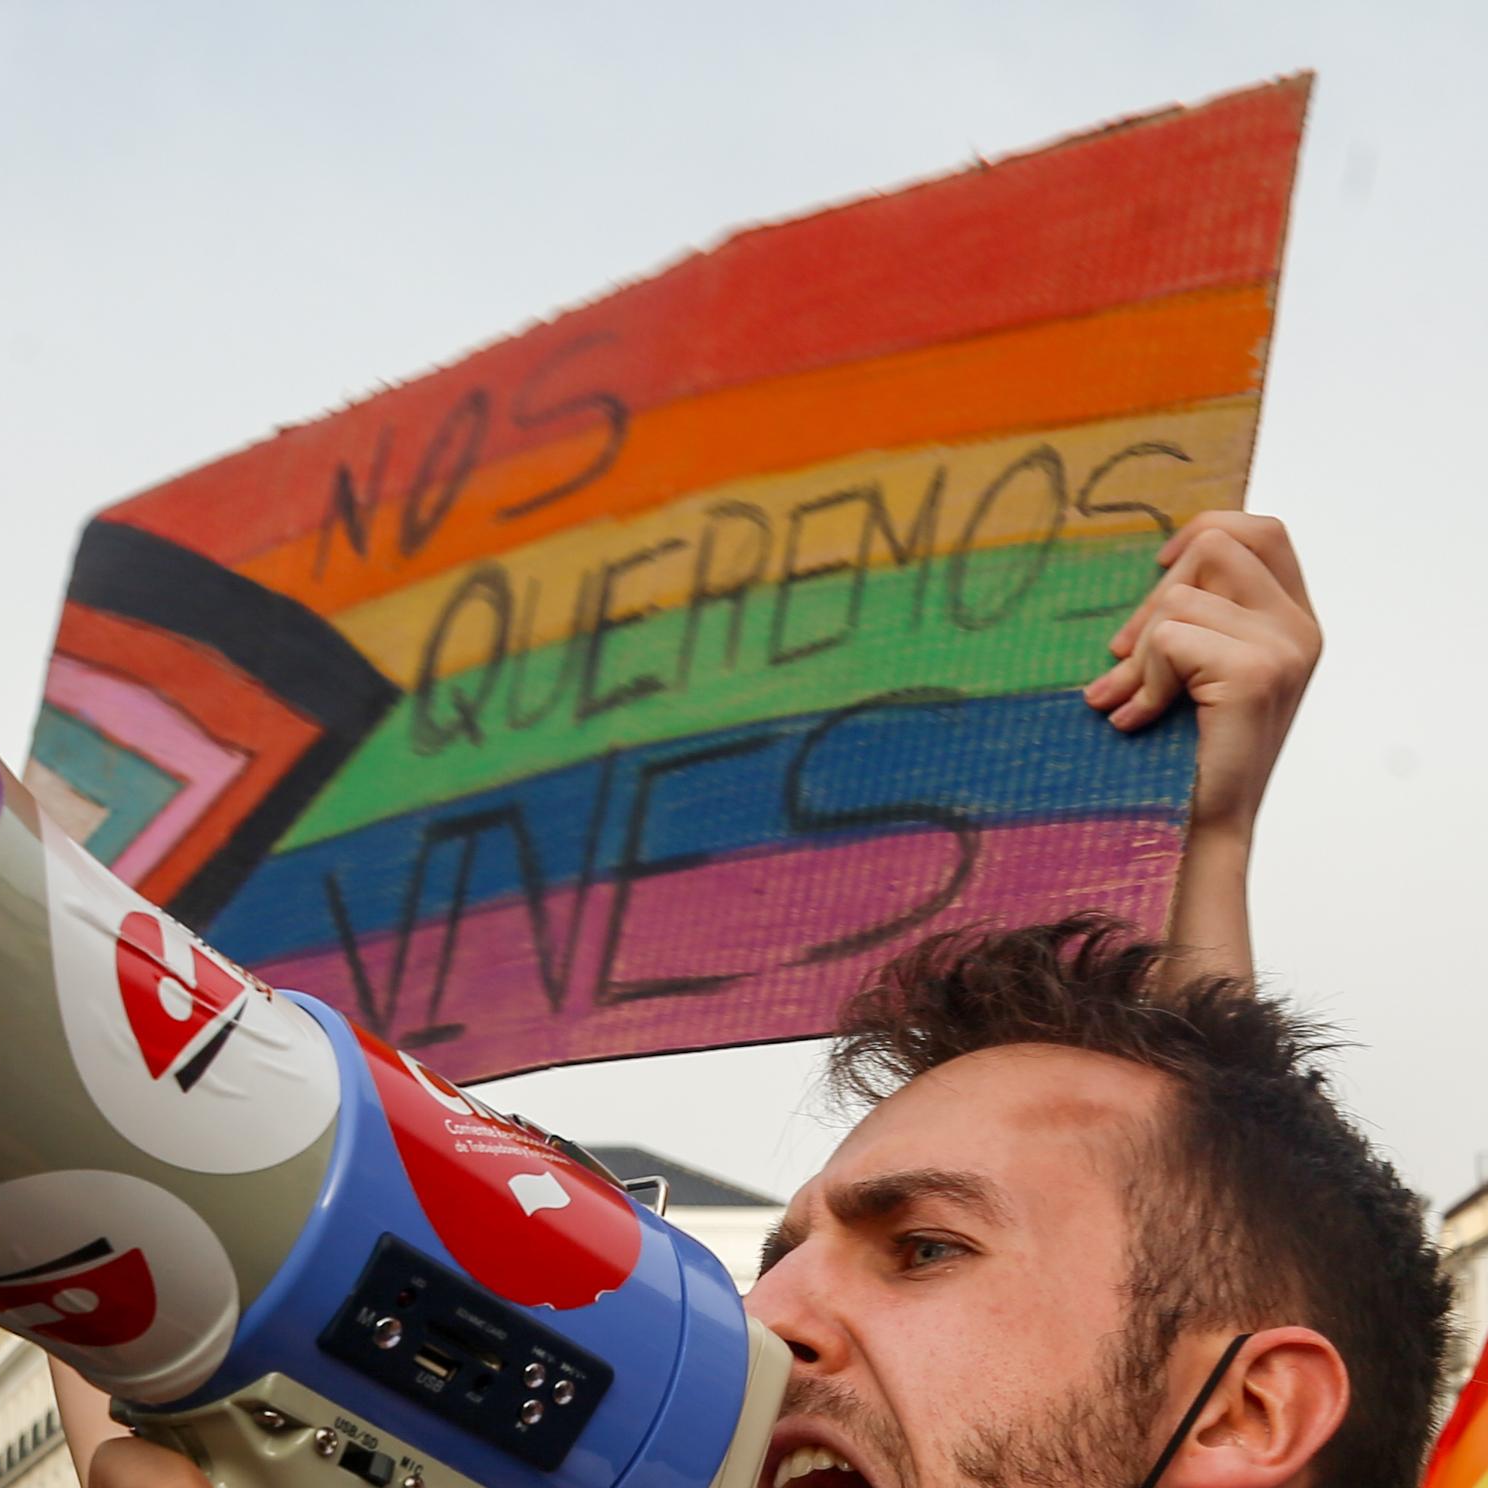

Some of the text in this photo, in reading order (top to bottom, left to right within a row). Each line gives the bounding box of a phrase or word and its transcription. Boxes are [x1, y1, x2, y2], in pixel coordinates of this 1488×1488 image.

[316, 331, 627, 570] NOS
[416, 442, 1190, 750] QUEREMOS
[327, 685, 981, 1048] VIVES
[333, 1416, 379, 1450] USB/SD
[415, 1370, 446, 1394] USB
[399, 1455, 424, 1477] MIC
